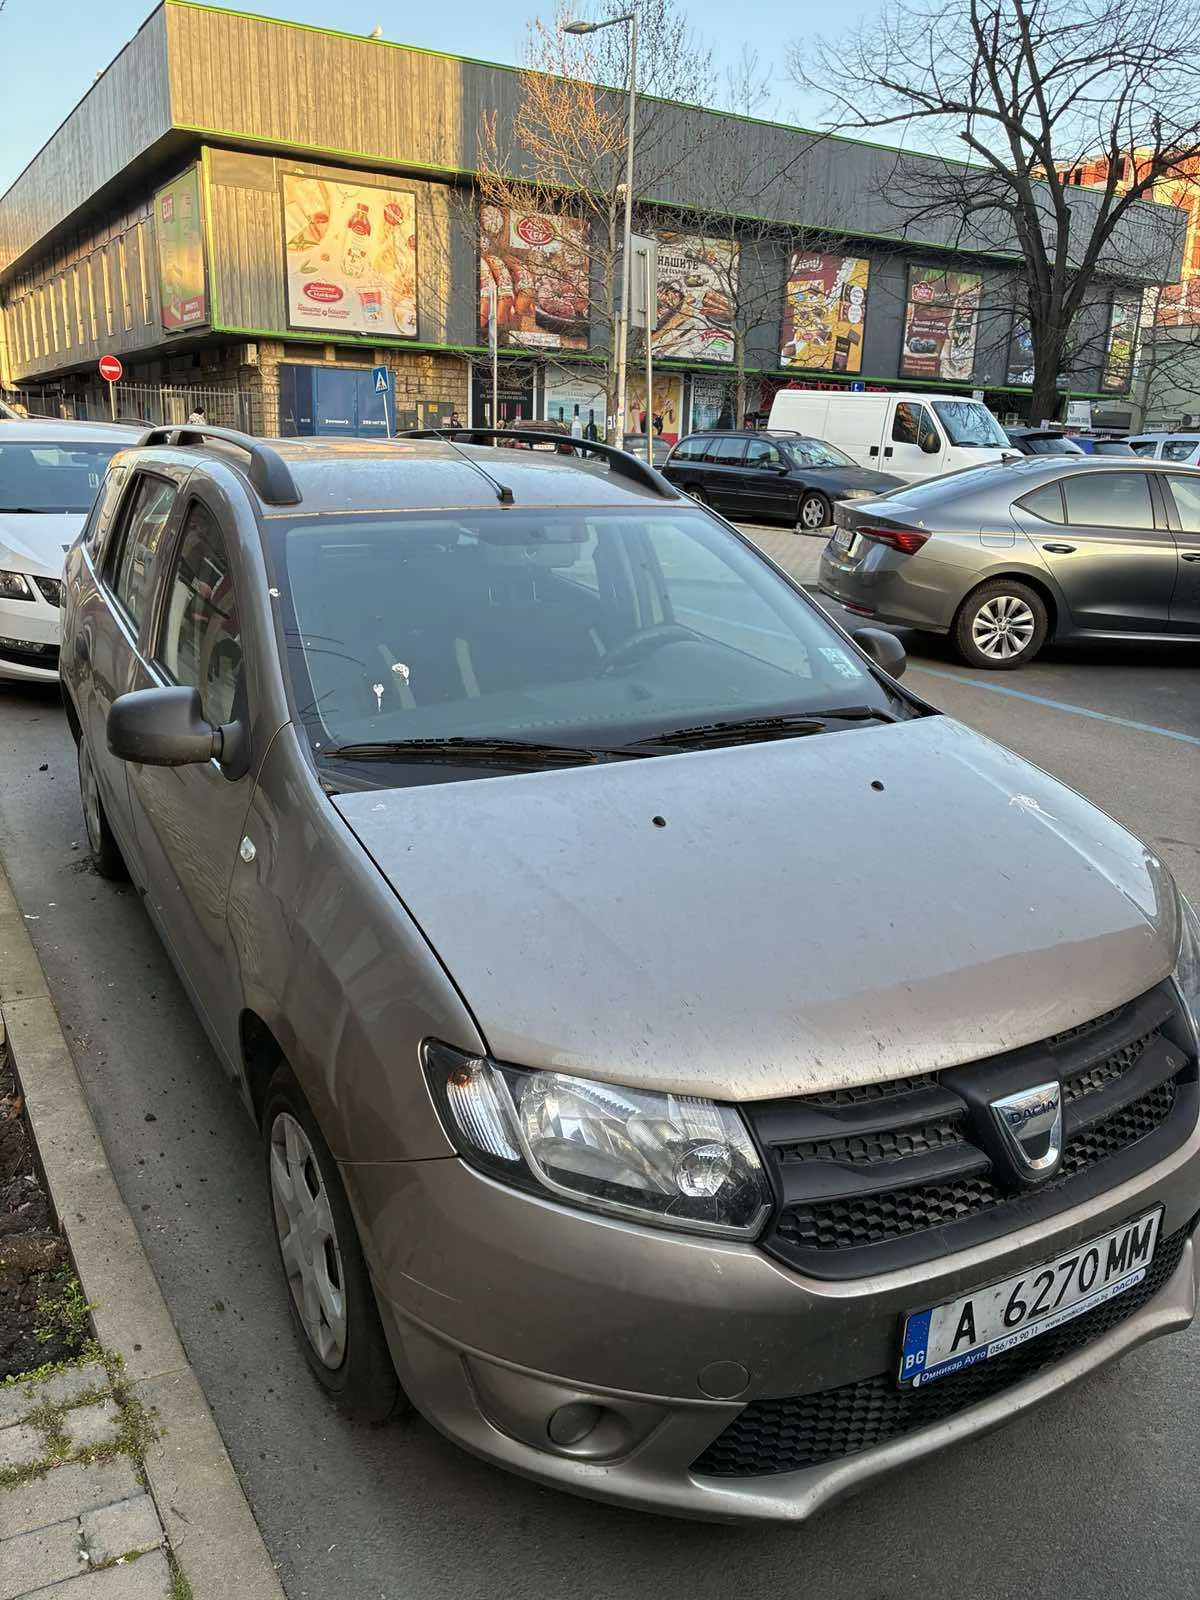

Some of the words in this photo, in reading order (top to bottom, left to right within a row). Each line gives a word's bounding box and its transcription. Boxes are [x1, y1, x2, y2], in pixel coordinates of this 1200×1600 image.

[657, 255, 699, 270] НАШИТЕ
[1010, 1100, 1057, 1124] DACIA
[921, 1360, 963, 1382] Омникар
[963, 1350, 987, 1366] Ауто
[1112, 1274, 1140, 1294] DACIA
[950, 1300, 977, 1353] A
[905, 1350, 925, 1370] BG
